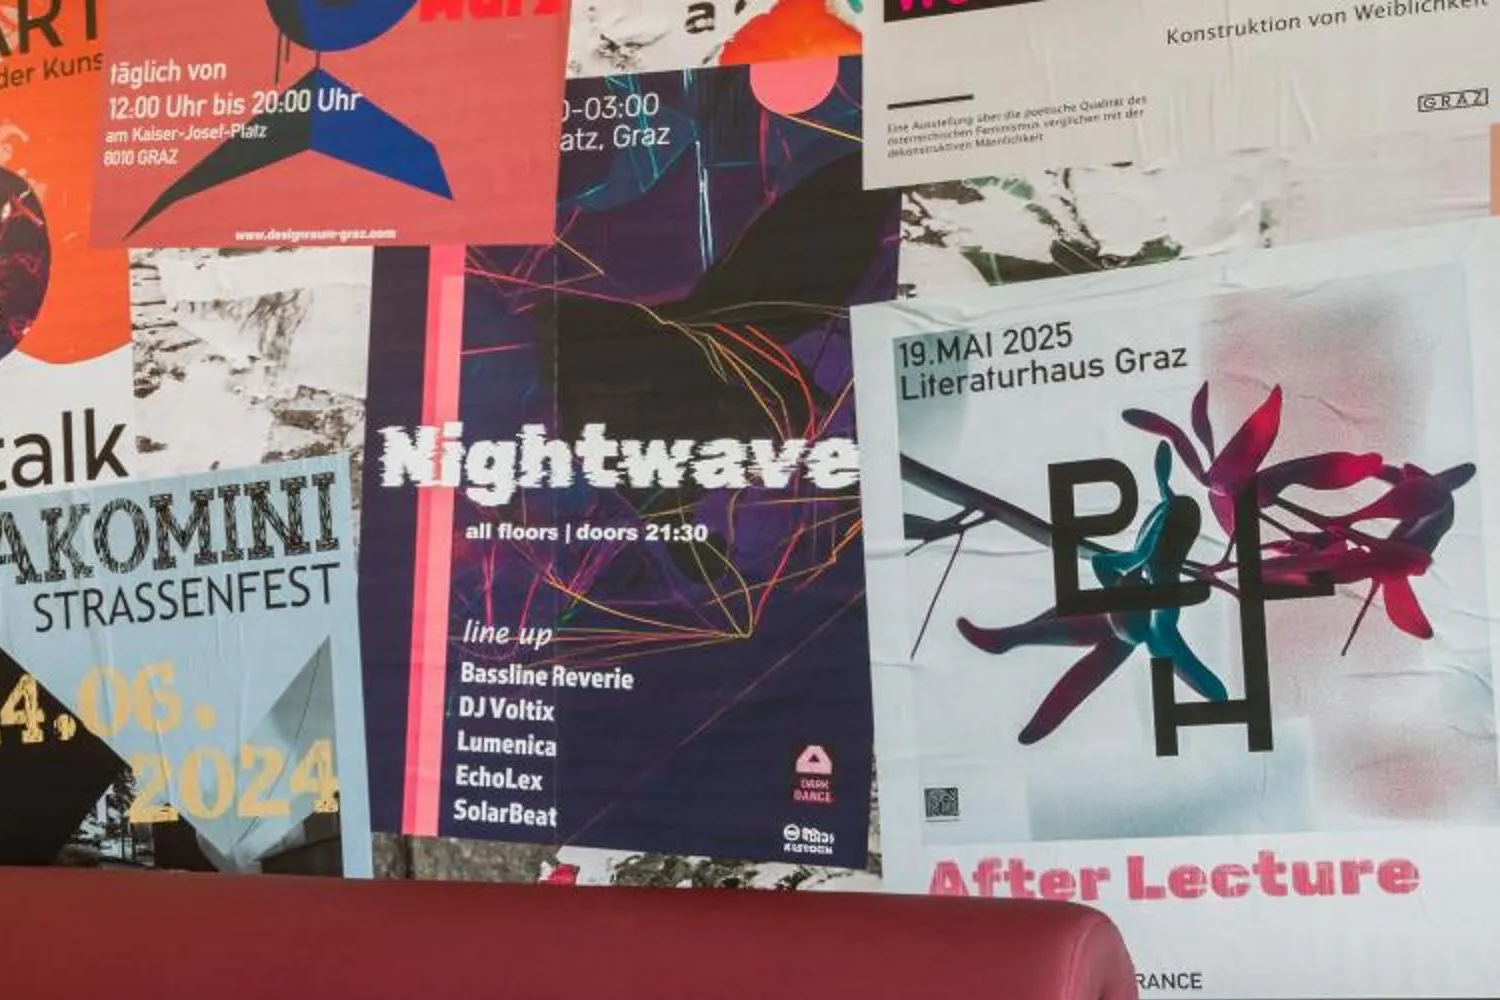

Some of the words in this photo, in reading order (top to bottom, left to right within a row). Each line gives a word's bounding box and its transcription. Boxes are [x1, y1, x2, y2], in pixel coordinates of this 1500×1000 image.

[1167, 16, 1301, 44] Konstruktion
[1308, 11, 1347, 28] von
[111, 60, 181, 88] täglich
[188, 62, 227, 82] von
[109, 96, 159, 120] 12:00
[166, 94, 209, 118] Uhr
[212, 91, 245, 116] bis
[252, 89, 311, 114] 20:00
[317, 87, 363, 112] Uhr
[1421, 90, 1487, 110] GRAZ
[105, 130, 127, 143] am
[132, 123, 267, 142] Kaiser-Josef-Platz
[613, 124, 671, 148] Graz
[104, 151, 134, 167] 8010
[138, 148, 179, 166] GRAZ
[900, 331, 993, 368] 19.MAI
[1003, 321, 1074, 355] 2025
[901, 358, 1105, 401] Literaturhaus
[1114, 347, 1188, 374] Graz
[377, 421, 861, 507] Nightwave
[466, 523, 491, 541] all
[498, 521, 559, 542] floors
[576, 521, 639, 541] doors
[646, 522, 709, 542] 21:30
[34, 562, 341, 632] STRASSENFEST
[463, 618, 510, 645] line
[519, 627, 554, 650] up
[460, 661, 549, 687] Bassline
[552, 664, 635, 690] Reverie
[458, 695, 486, 718] DJ
[490, 696, 555, 721] Voltix
[456, 729, 558, 757] Lumenica
[128, 739, 340, 823] 2024
[454, 764, 544, 791] EchoLex
[453, 798, 558, 828] SolarBeat
[928, 856, 1112, 900] After
[1125, 849, 1421, 901] Lecture
[1135, 973, 1203, 990] RANCE
